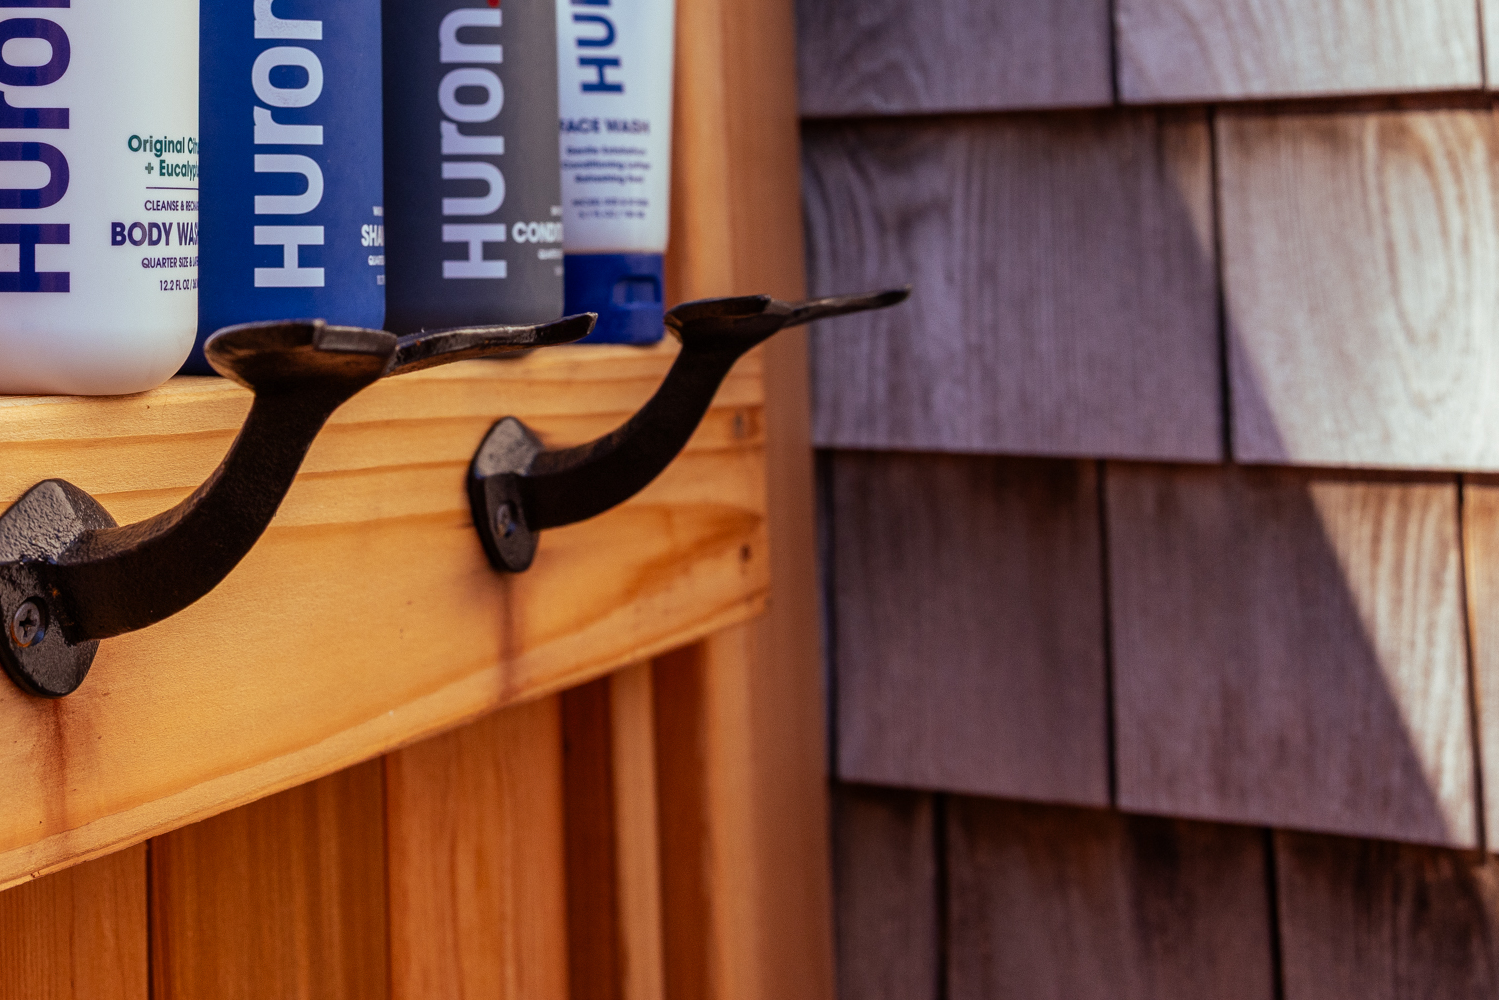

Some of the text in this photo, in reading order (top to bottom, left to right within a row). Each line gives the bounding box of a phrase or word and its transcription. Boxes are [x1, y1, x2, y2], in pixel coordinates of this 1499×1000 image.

[128, 134, 185, 158] Original
[144, 200, 179, 212] CLEANSE
[111, 221, 198, 247] BODY WAS
[141, 257, 178, 269] QUARTER
[178, 256, 189, 268] SIZE
[159, 280, 175, 292] 12.2
[175, 279, 182, 291] FL
[182, 278, 190, 291] OZ
